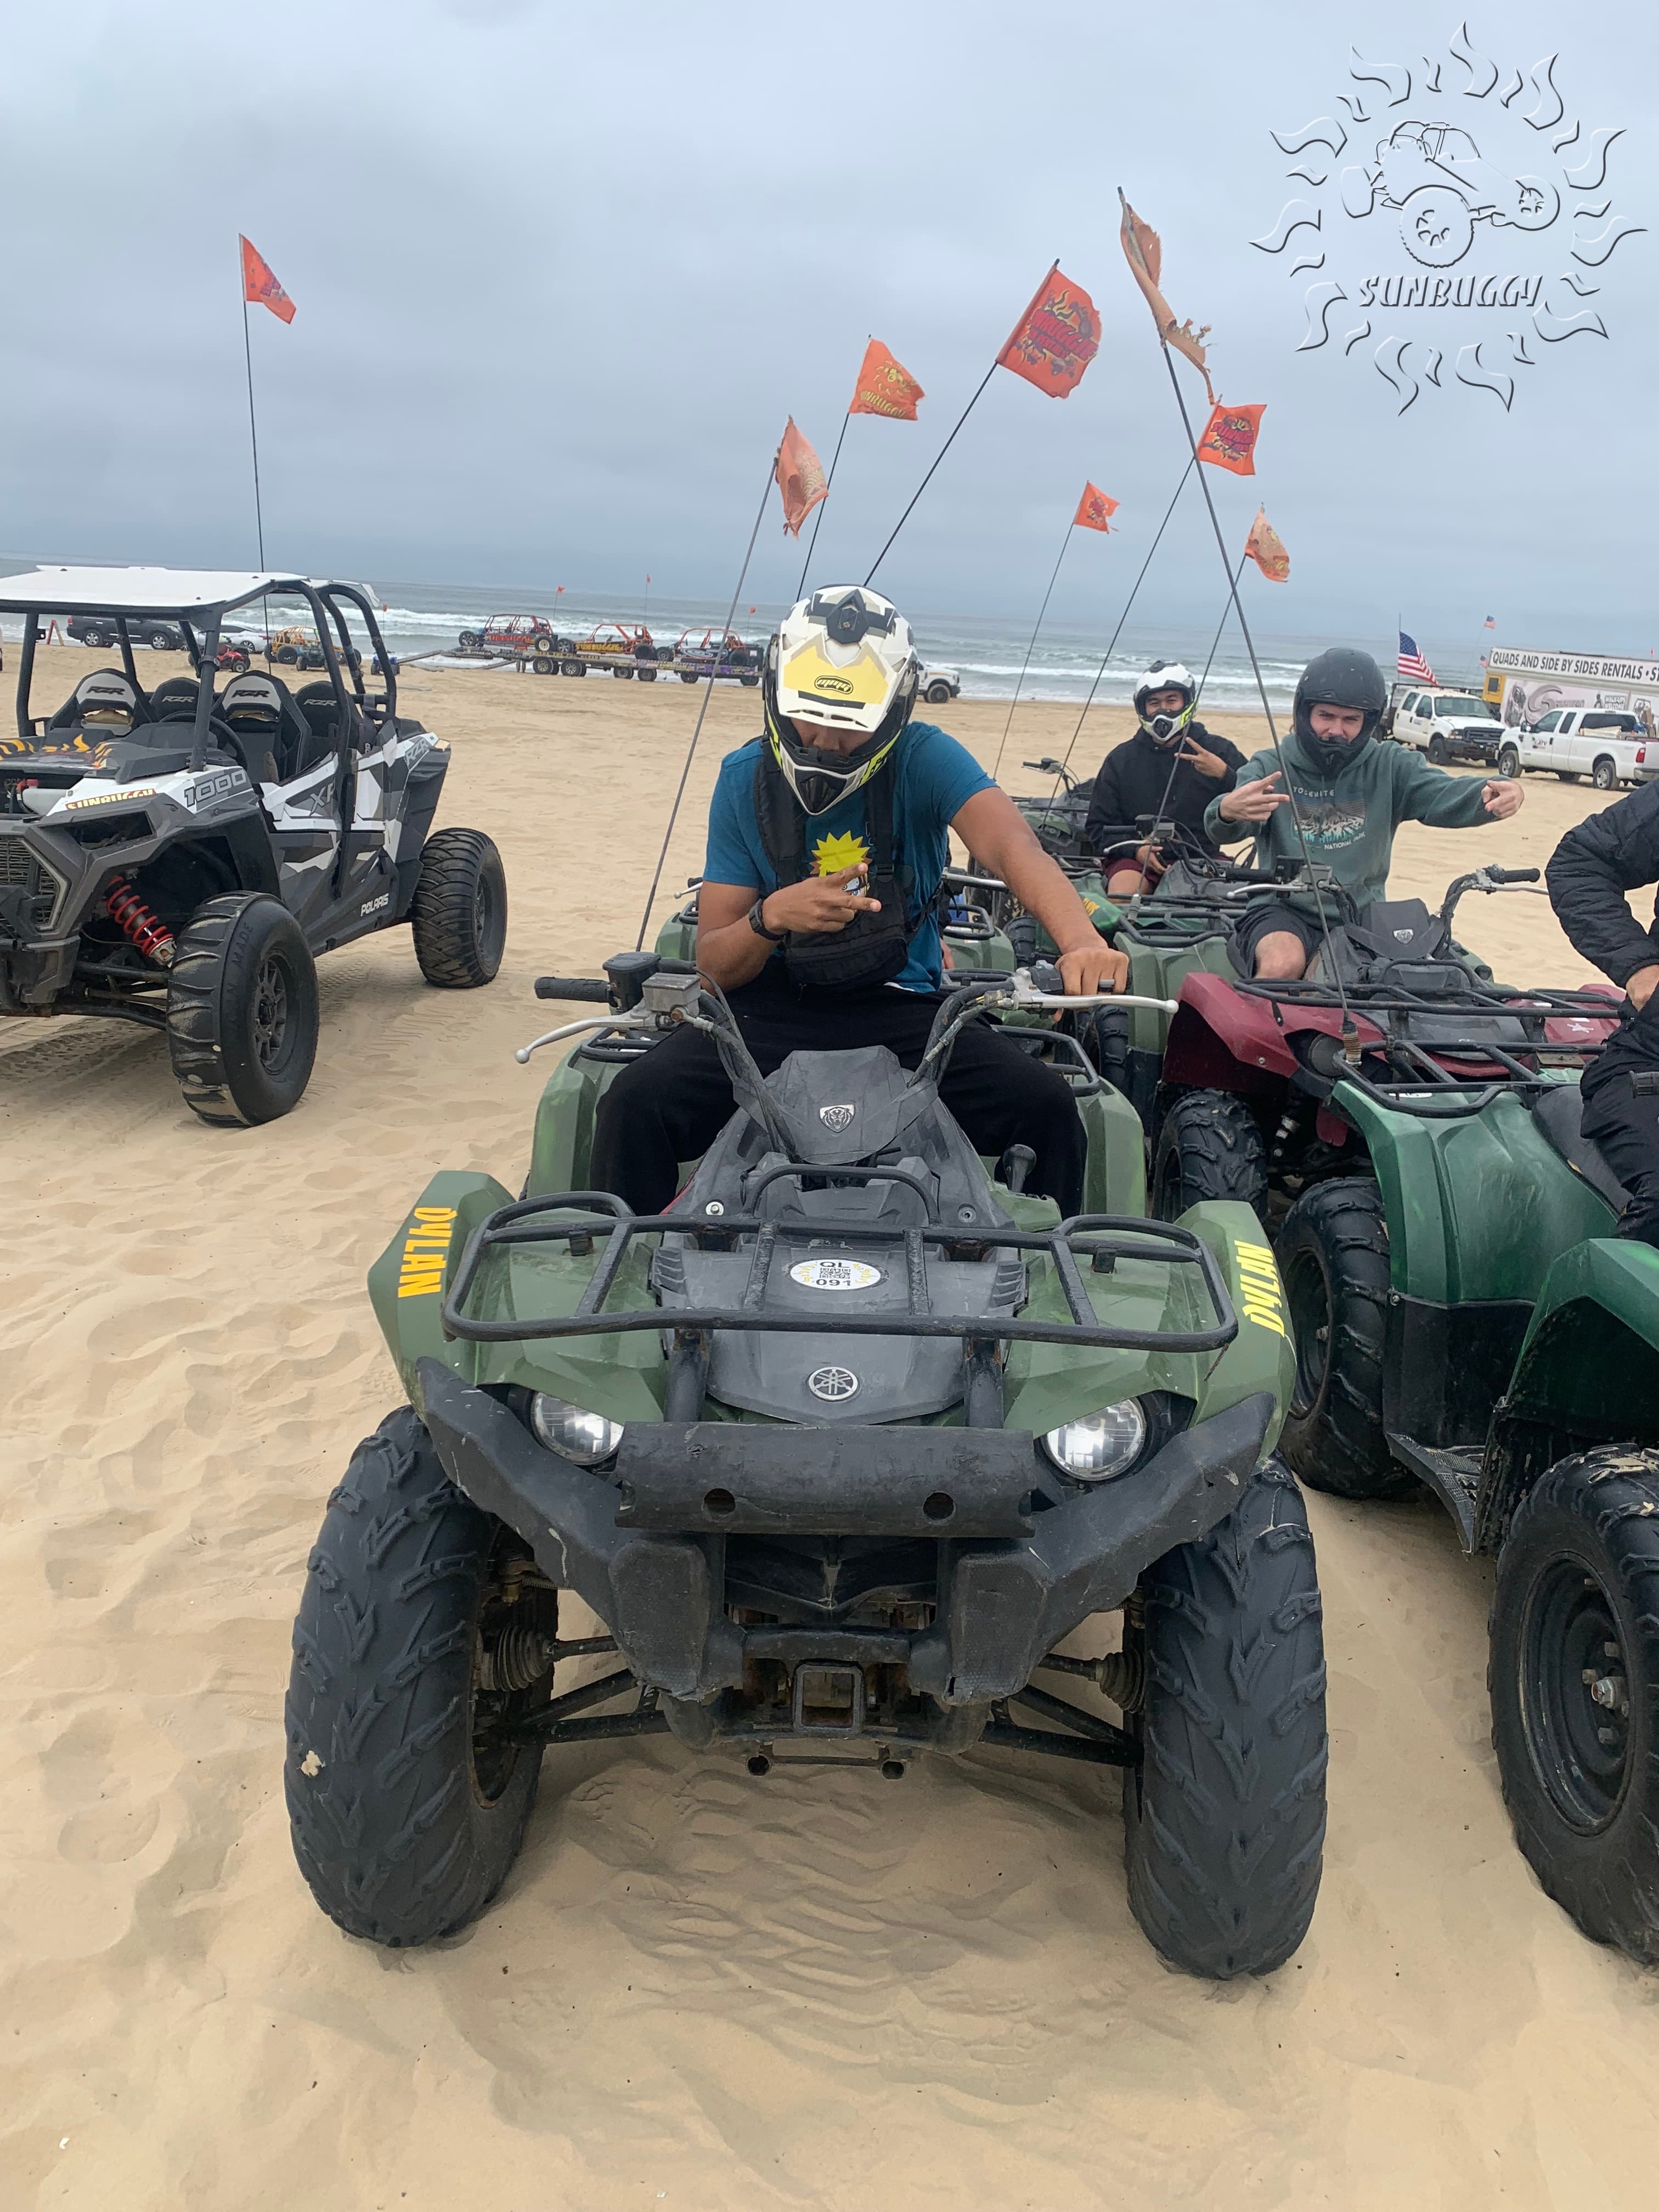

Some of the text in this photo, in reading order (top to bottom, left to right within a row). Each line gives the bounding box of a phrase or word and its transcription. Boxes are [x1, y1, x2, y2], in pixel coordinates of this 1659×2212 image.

[1493, 651, 1520, 665] QUADS
[1520, 656, 1539, 668] AND
[1541, 657, 1559, 671] SIDE
[1560, 659, 1572, 673] BY
[1574, 660, 1600, 675] SIDES
[1601, 663, 1643, 679] RENTALS
[86, 686, 126, 696] RZR
[161, 695, 195, 703] RZR
[232, 689, 270, 698] RZR
[303, 698, 338, 707] RZR
[184, 770, 247, 808] 1000
[1324, 840, 1352, 850] NATIONAL
[360, 893, 389, 917] POLARIS
[398, 1207, 458, 1298] DYLAN
[1234, 1240, 1285, 1338] DYLAN
